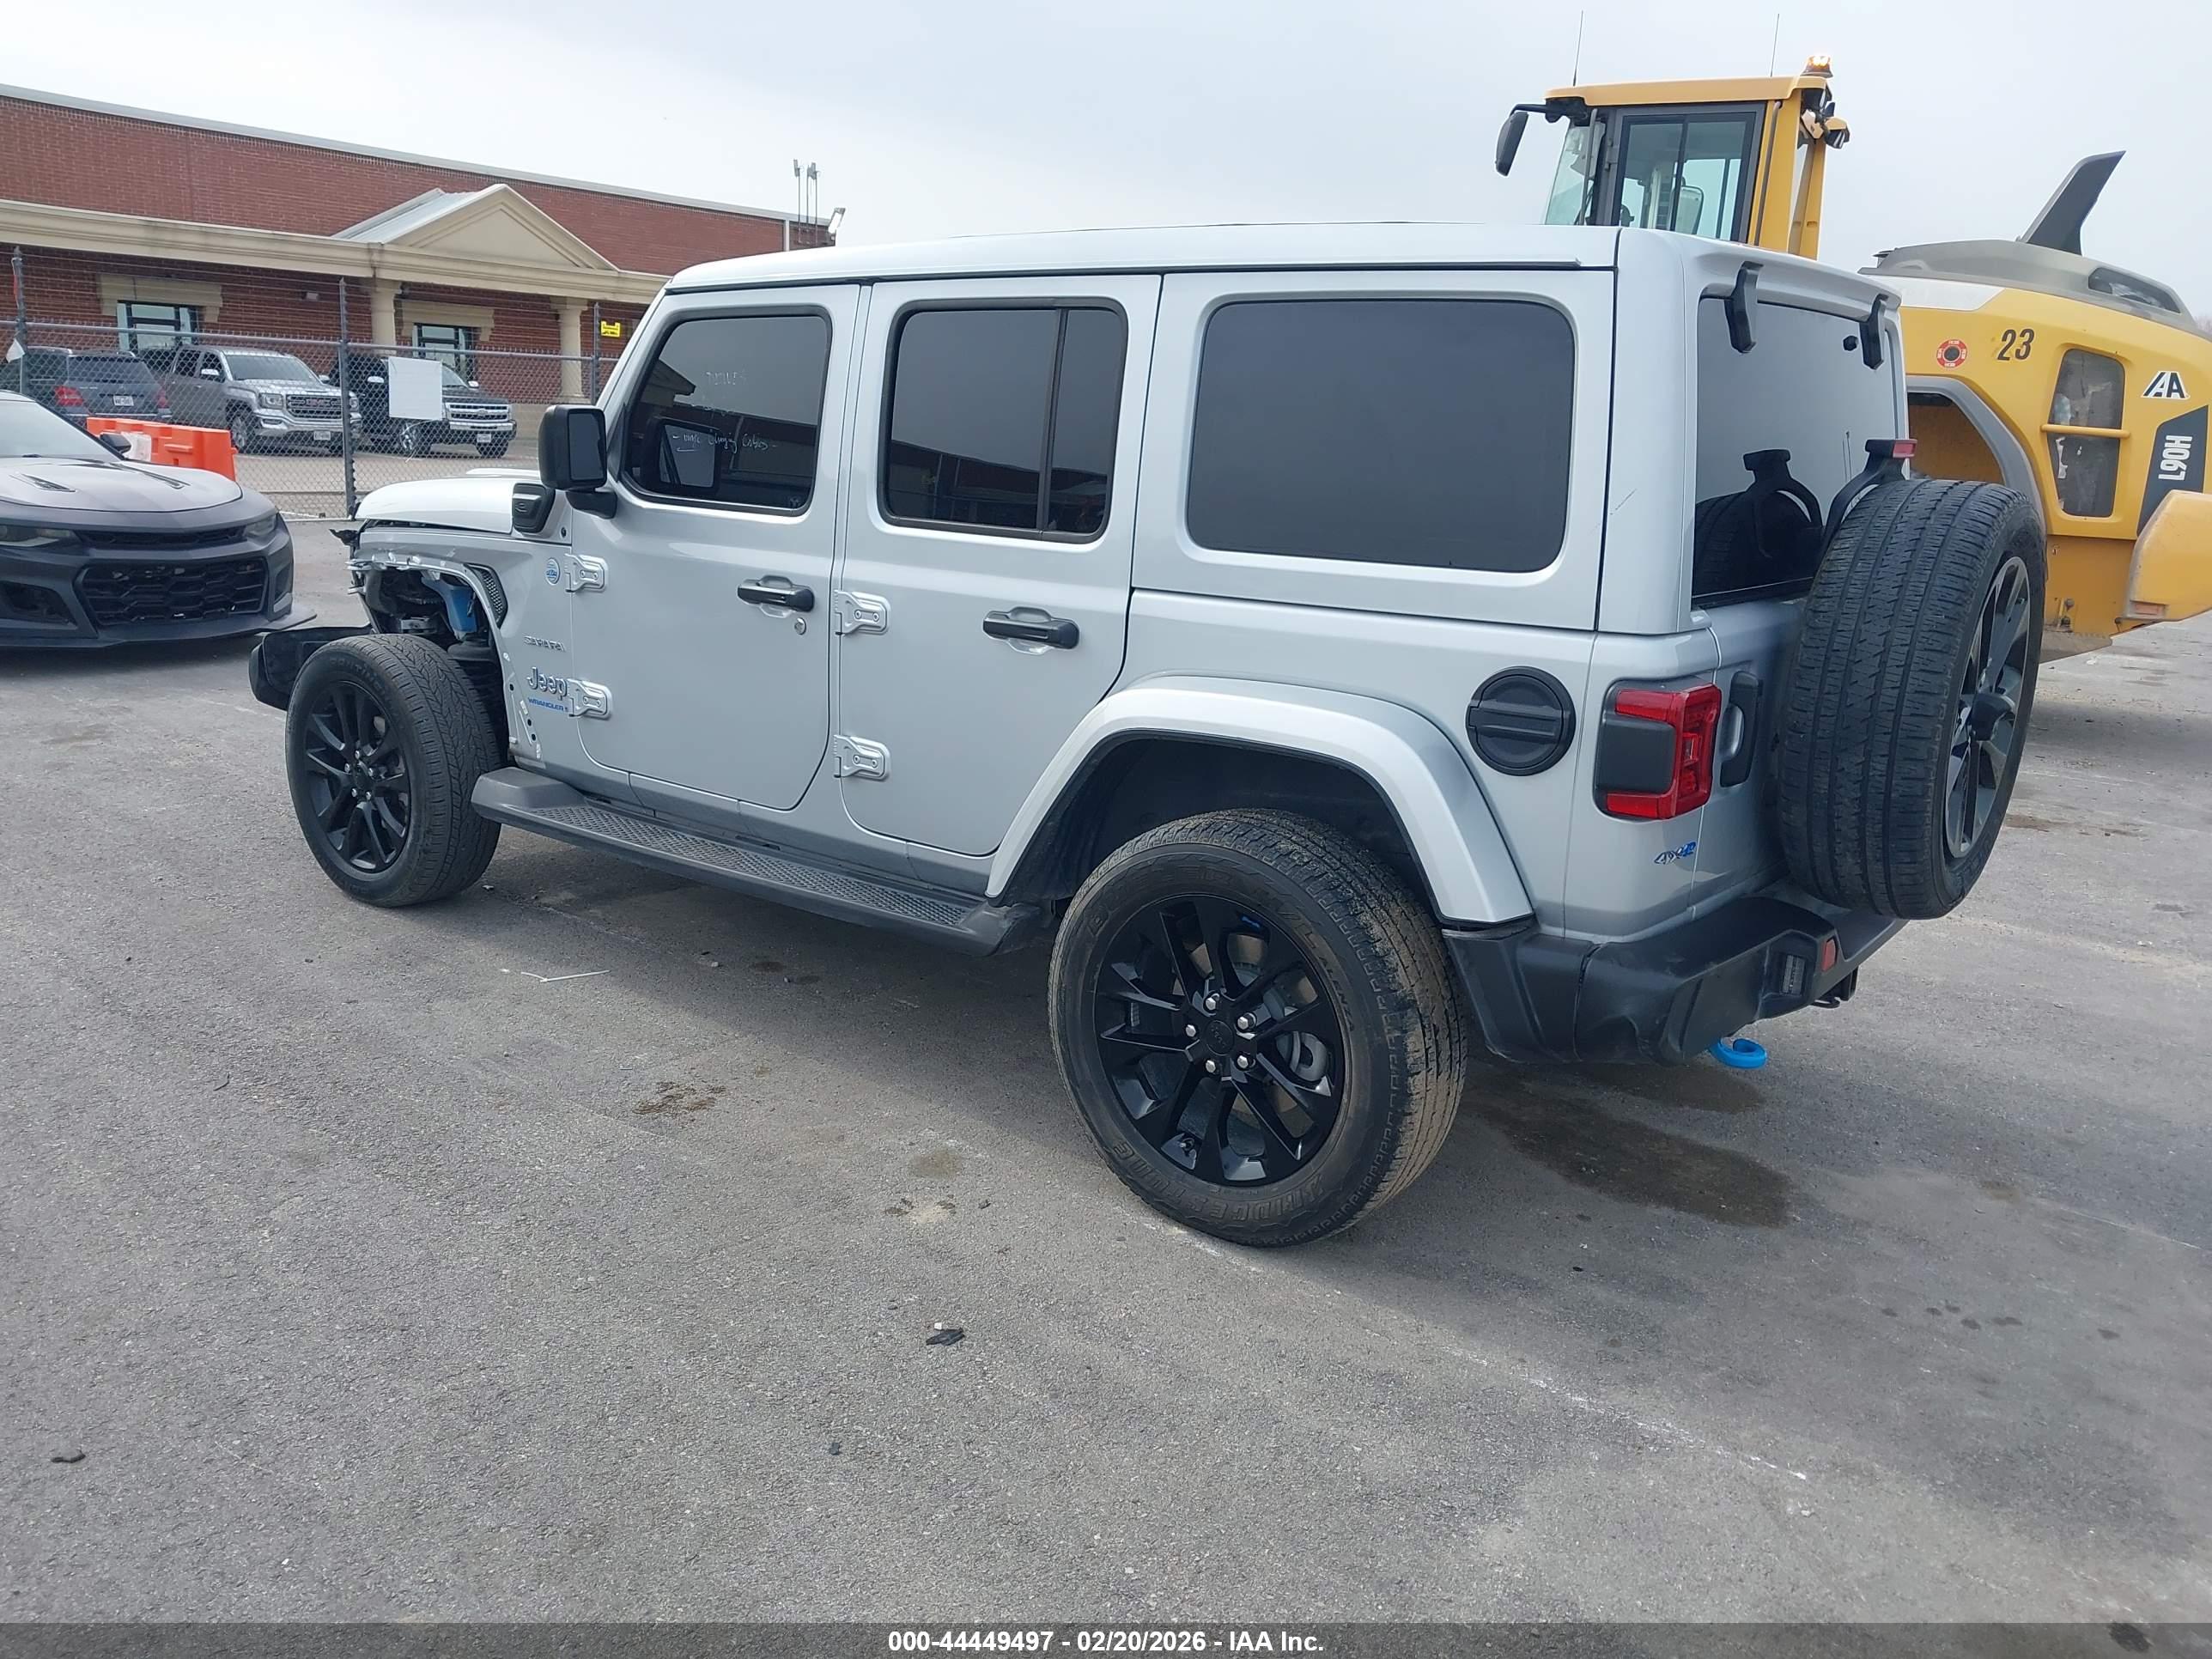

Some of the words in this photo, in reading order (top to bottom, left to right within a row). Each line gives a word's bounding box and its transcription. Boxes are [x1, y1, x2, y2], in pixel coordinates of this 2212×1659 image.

[1997, 328, 2035, 361] 23
[2158, 434, 2193, 481] L90H
[526, 666, 568, 702] Jeep
[527, 696, 564, 711] WRANGLER
